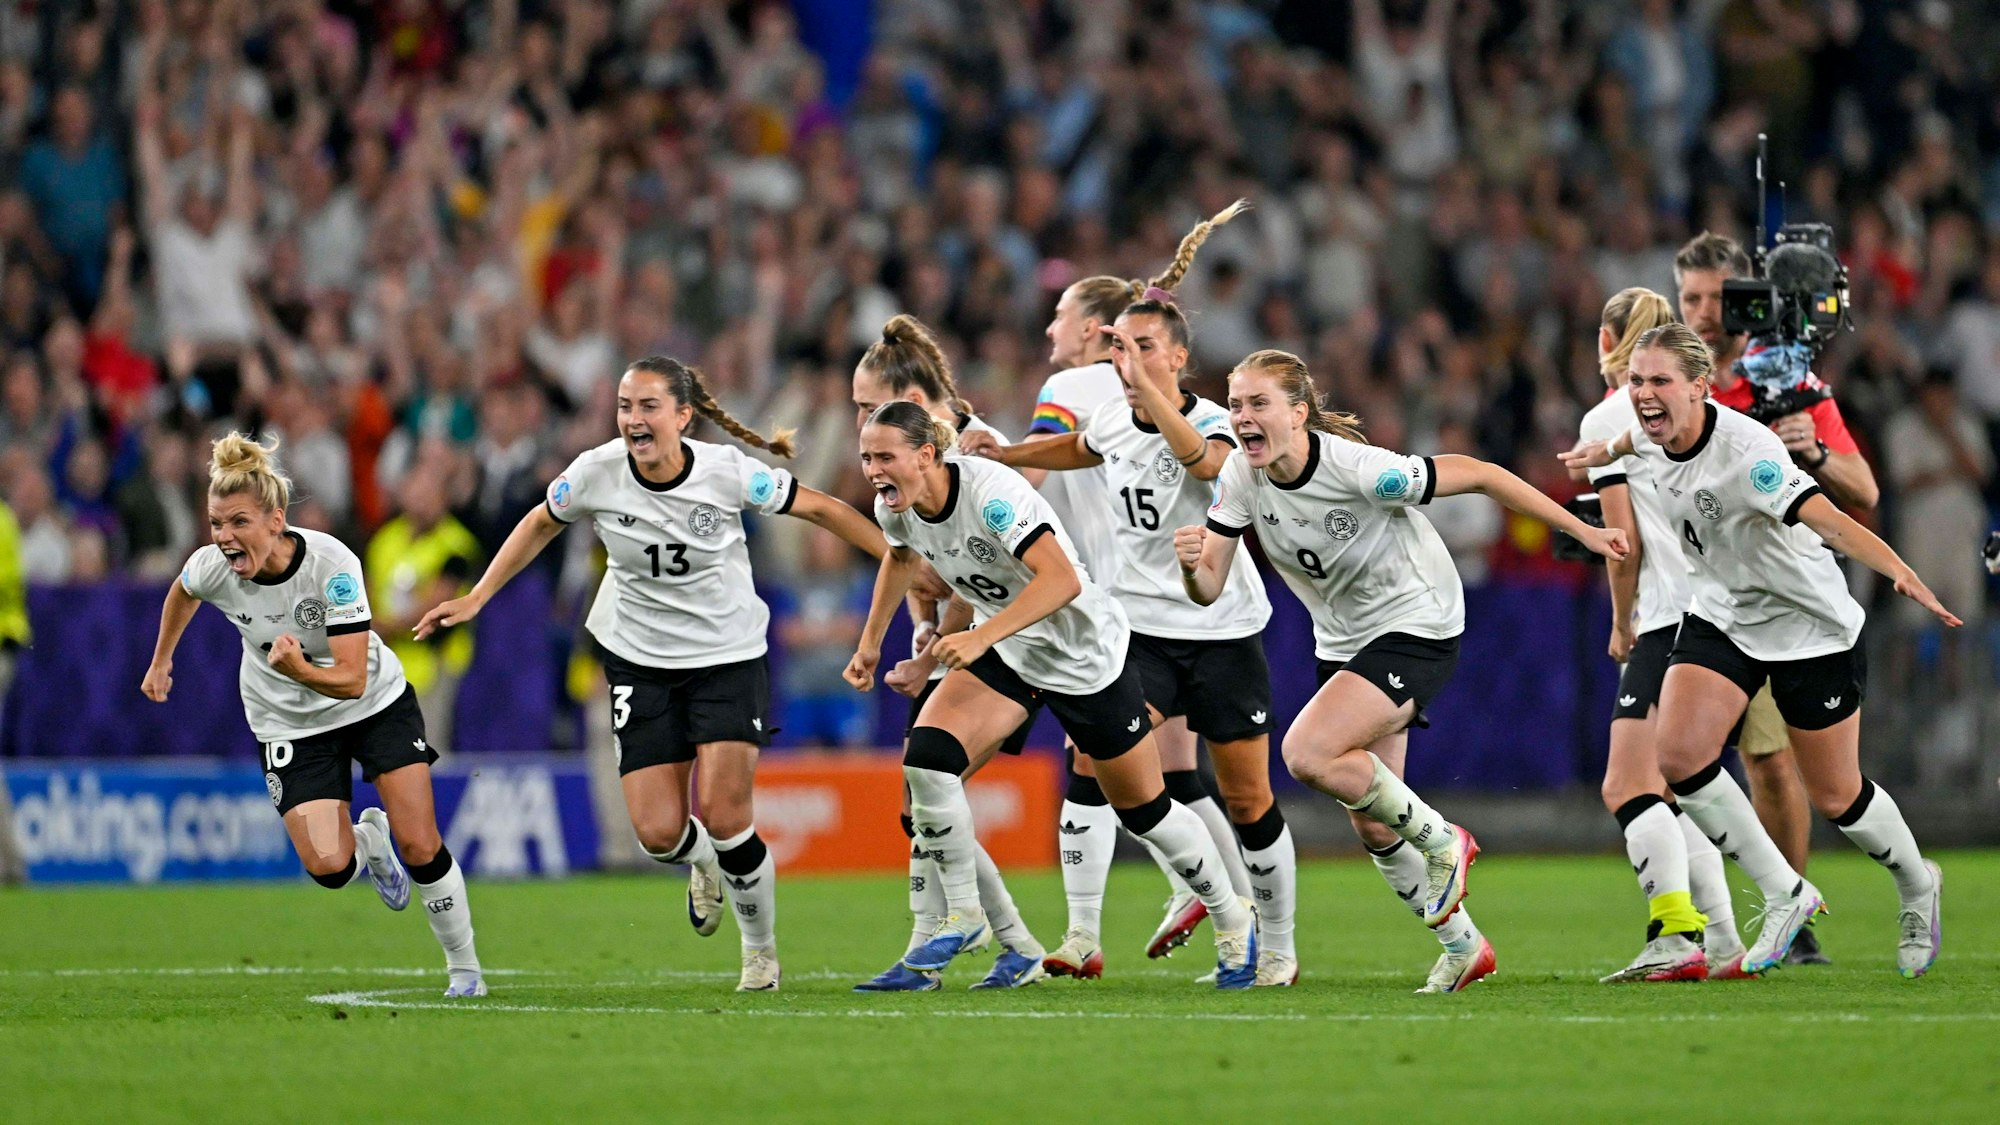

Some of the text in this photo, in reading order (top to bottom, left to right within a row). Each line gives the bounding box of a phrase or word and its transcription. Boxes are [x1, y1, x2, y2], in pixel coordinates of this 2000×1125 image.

[1120, 486, 1160, 531] 15
[1683, 519, 1704, 556] 4
[643, 543, 690, 578] 13
[1296, 548, 1328, 579] 9
[955, 573, 1010, 602] 19
[607, 684, 634, 729] 3
